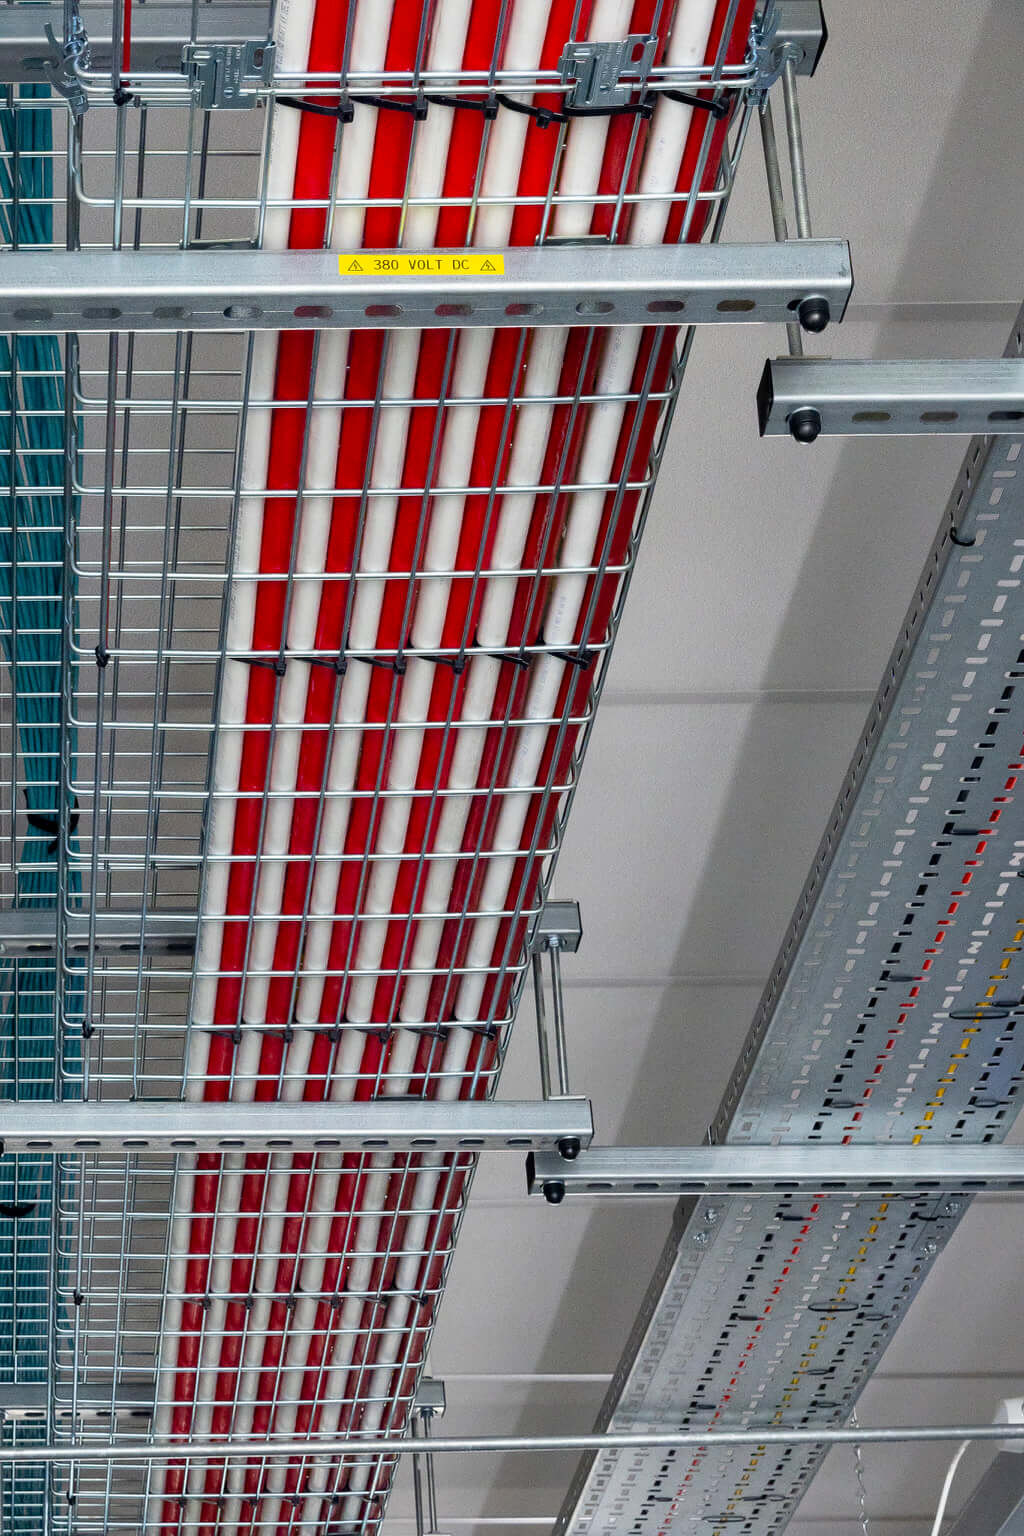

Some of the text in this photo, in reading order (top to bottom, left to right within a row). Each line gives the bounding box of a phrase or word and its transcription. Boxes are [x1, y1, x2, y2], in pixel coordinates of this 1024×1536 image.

[373, 259, 470, 271] 380 VOLT DC
